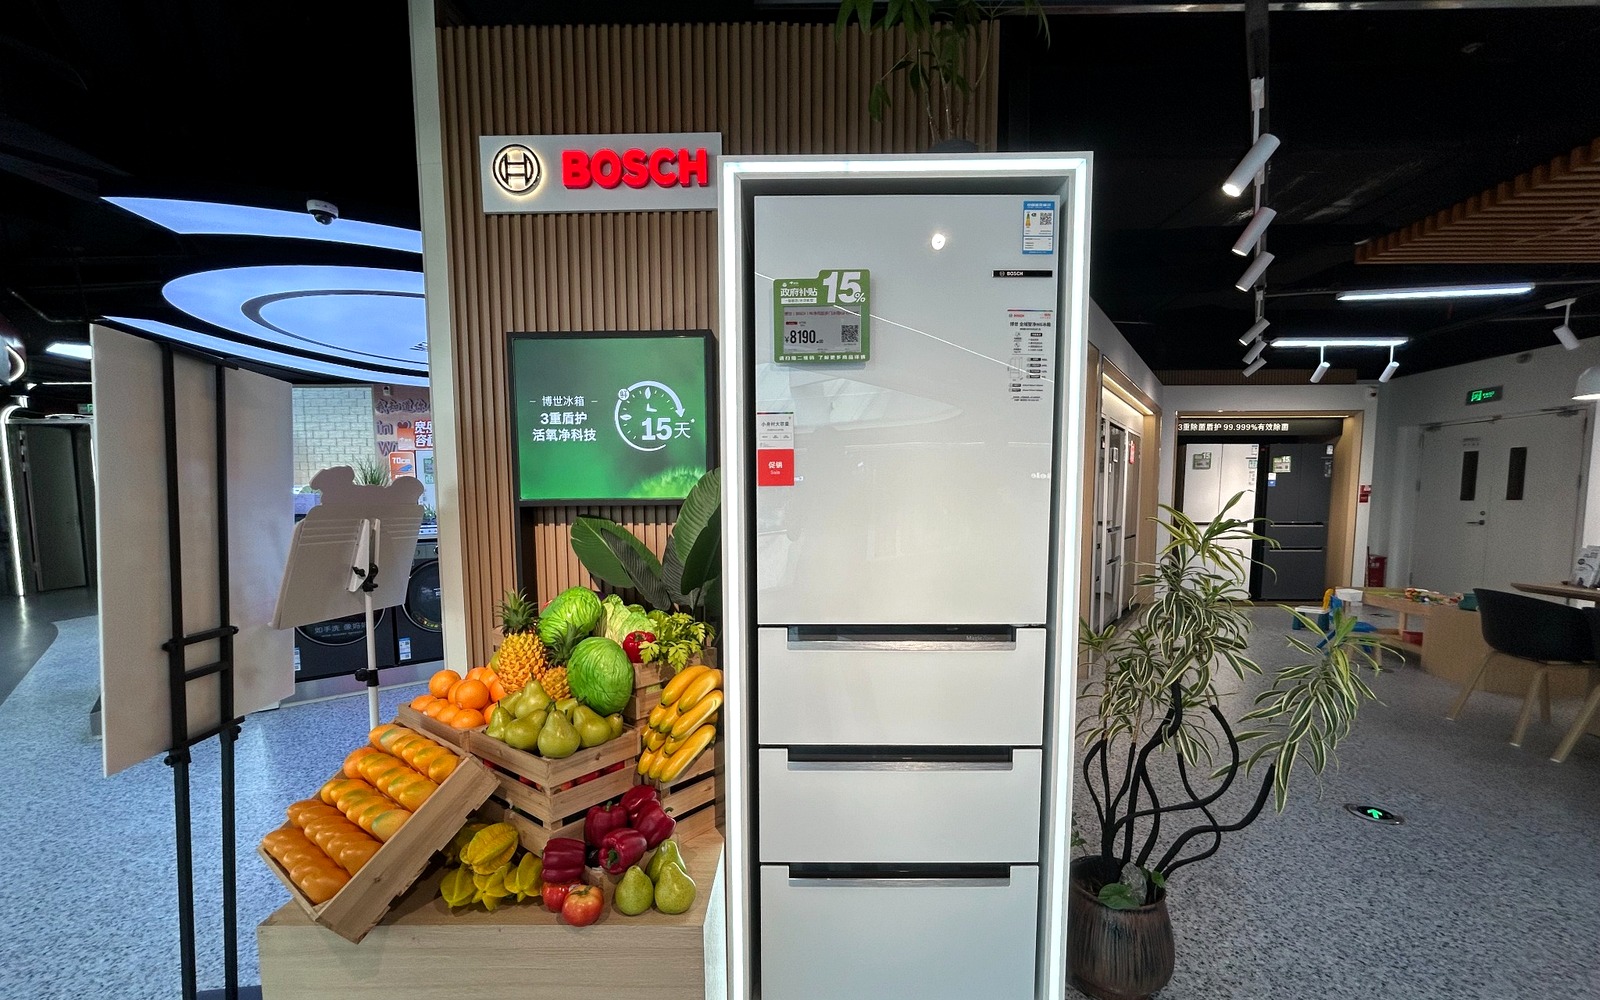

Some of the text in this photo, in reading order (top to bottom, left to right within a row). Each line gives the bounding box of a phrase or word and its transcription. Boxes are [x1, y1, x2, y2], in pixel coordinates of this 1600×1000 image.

[562, 148, 708, 189] BOSCH
[780, 288, 818, 297] 政府补贴
[822, 271, 866, 304] 15%
[541, 395, 585, 407] 博世冰箱
[540, 412, 588, 425] 3重盾护
[1177, 422, 1289, 432] 3重除菌盾护 99.999%有效除菌
[532, 428, 597, 442] 活氧净科技
